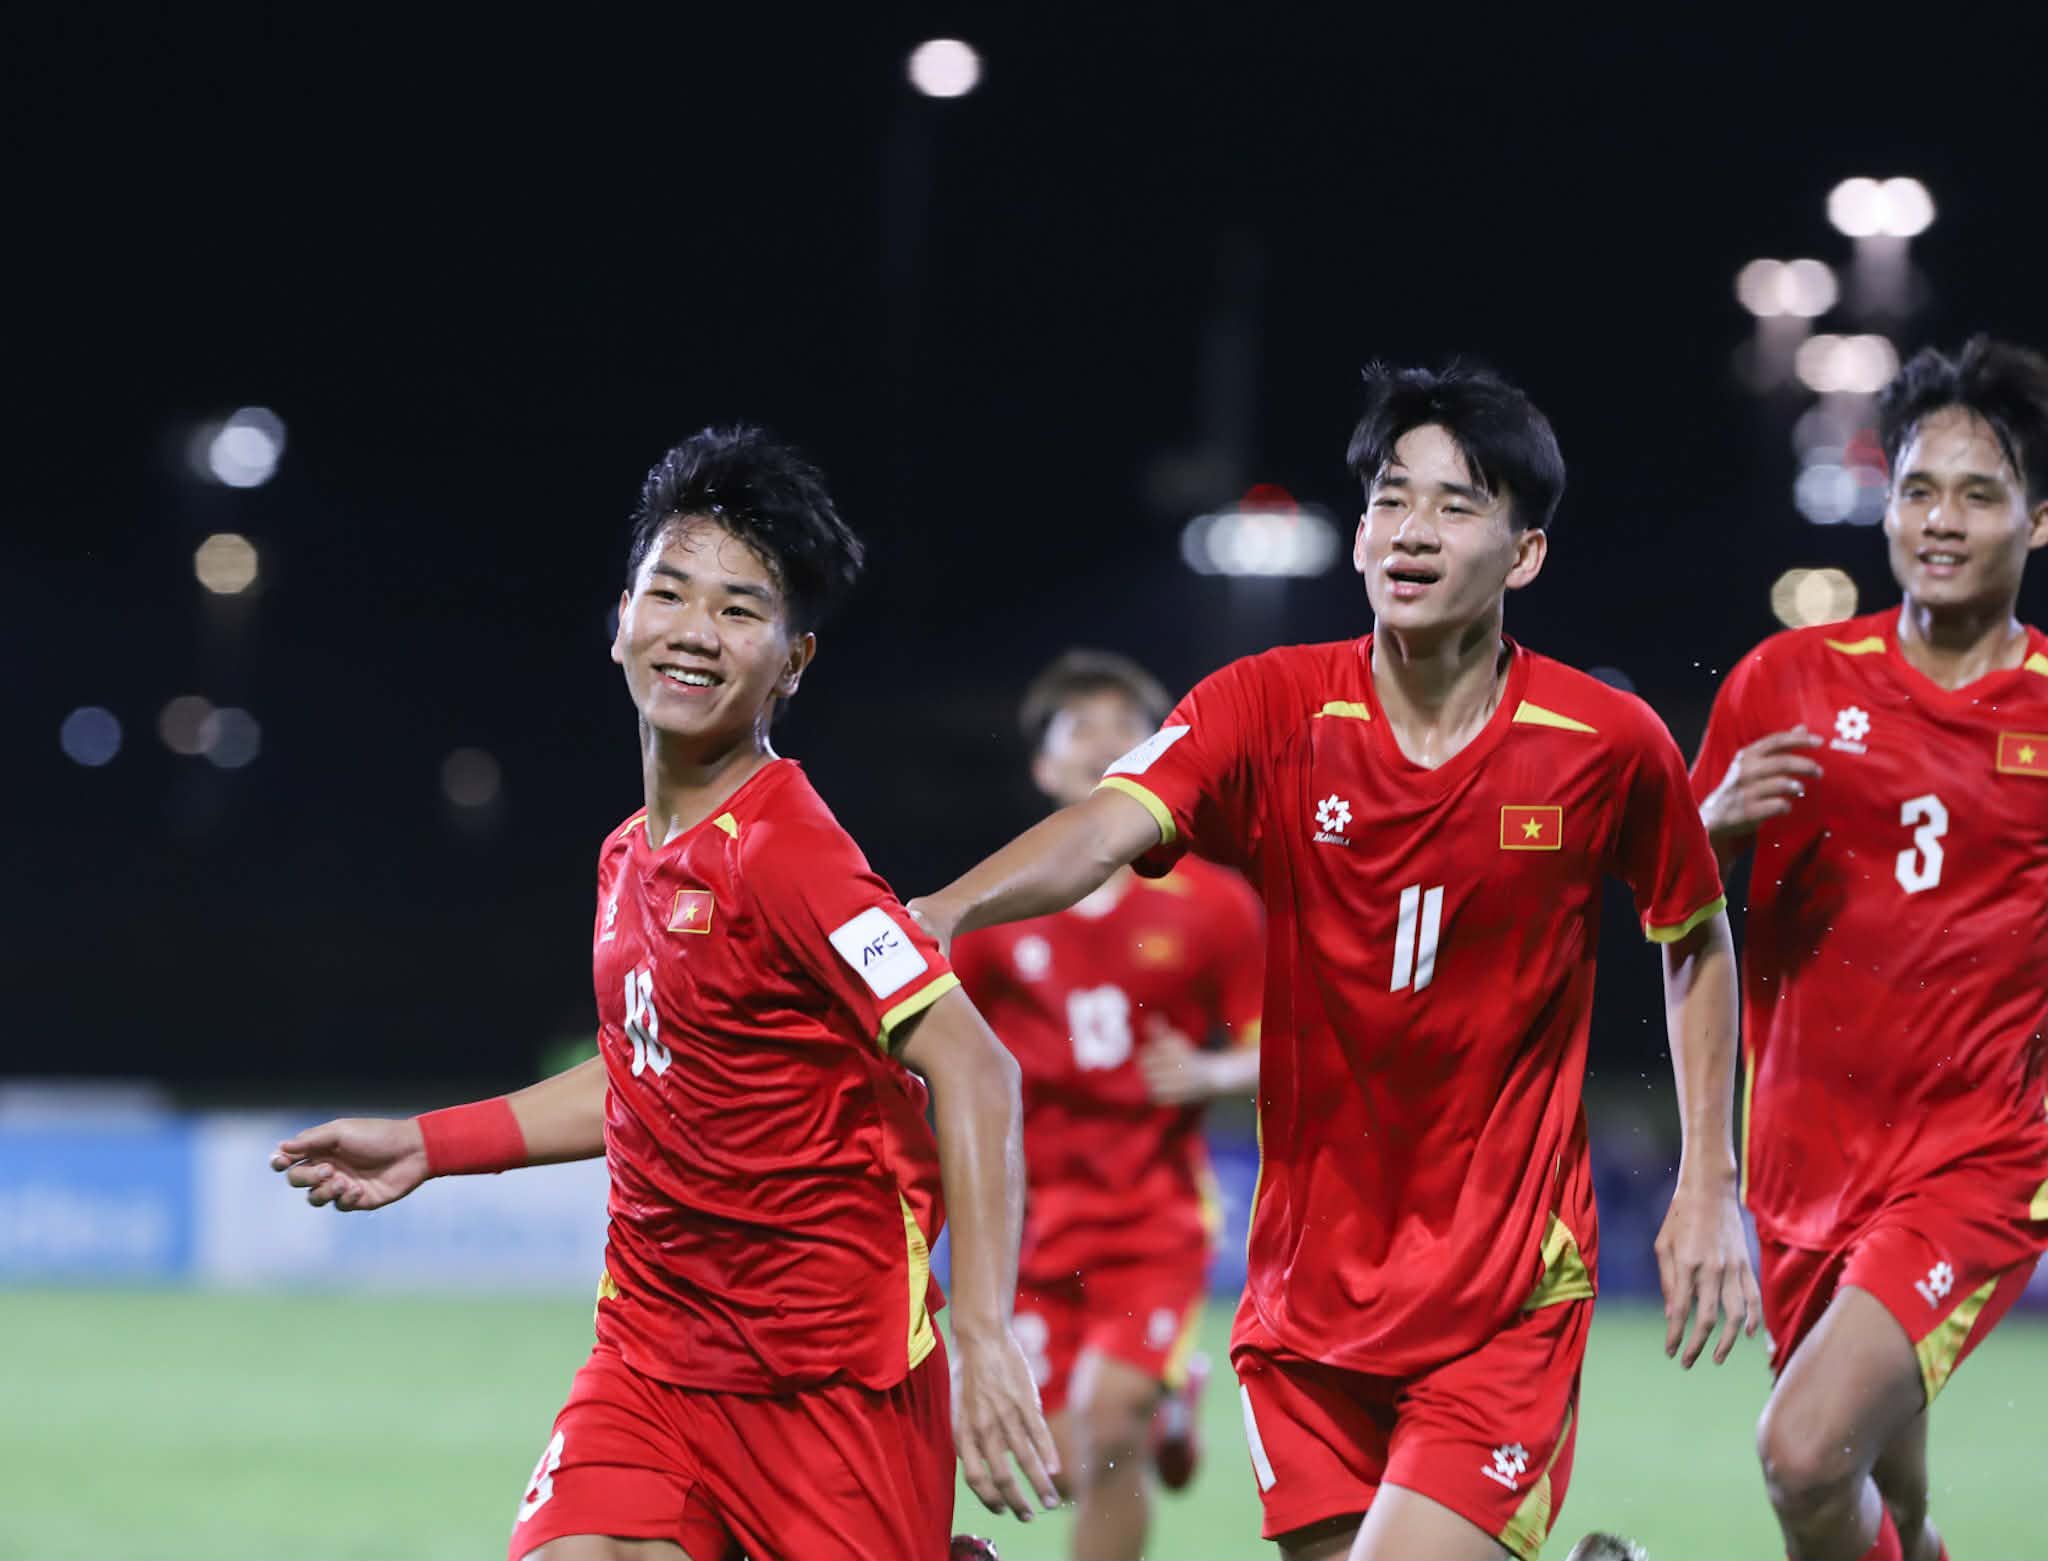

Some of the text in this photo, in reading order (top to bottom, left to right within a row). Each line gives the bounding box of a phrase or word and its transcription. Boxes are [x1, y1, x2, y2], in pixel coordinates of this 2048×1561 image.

[1896, 793, 1949, 895] 3
[864, 930, 899, 967] AFC
[1390, 884, 1445, 993] 11
[1240, 1384, 1277, 1494] 1
